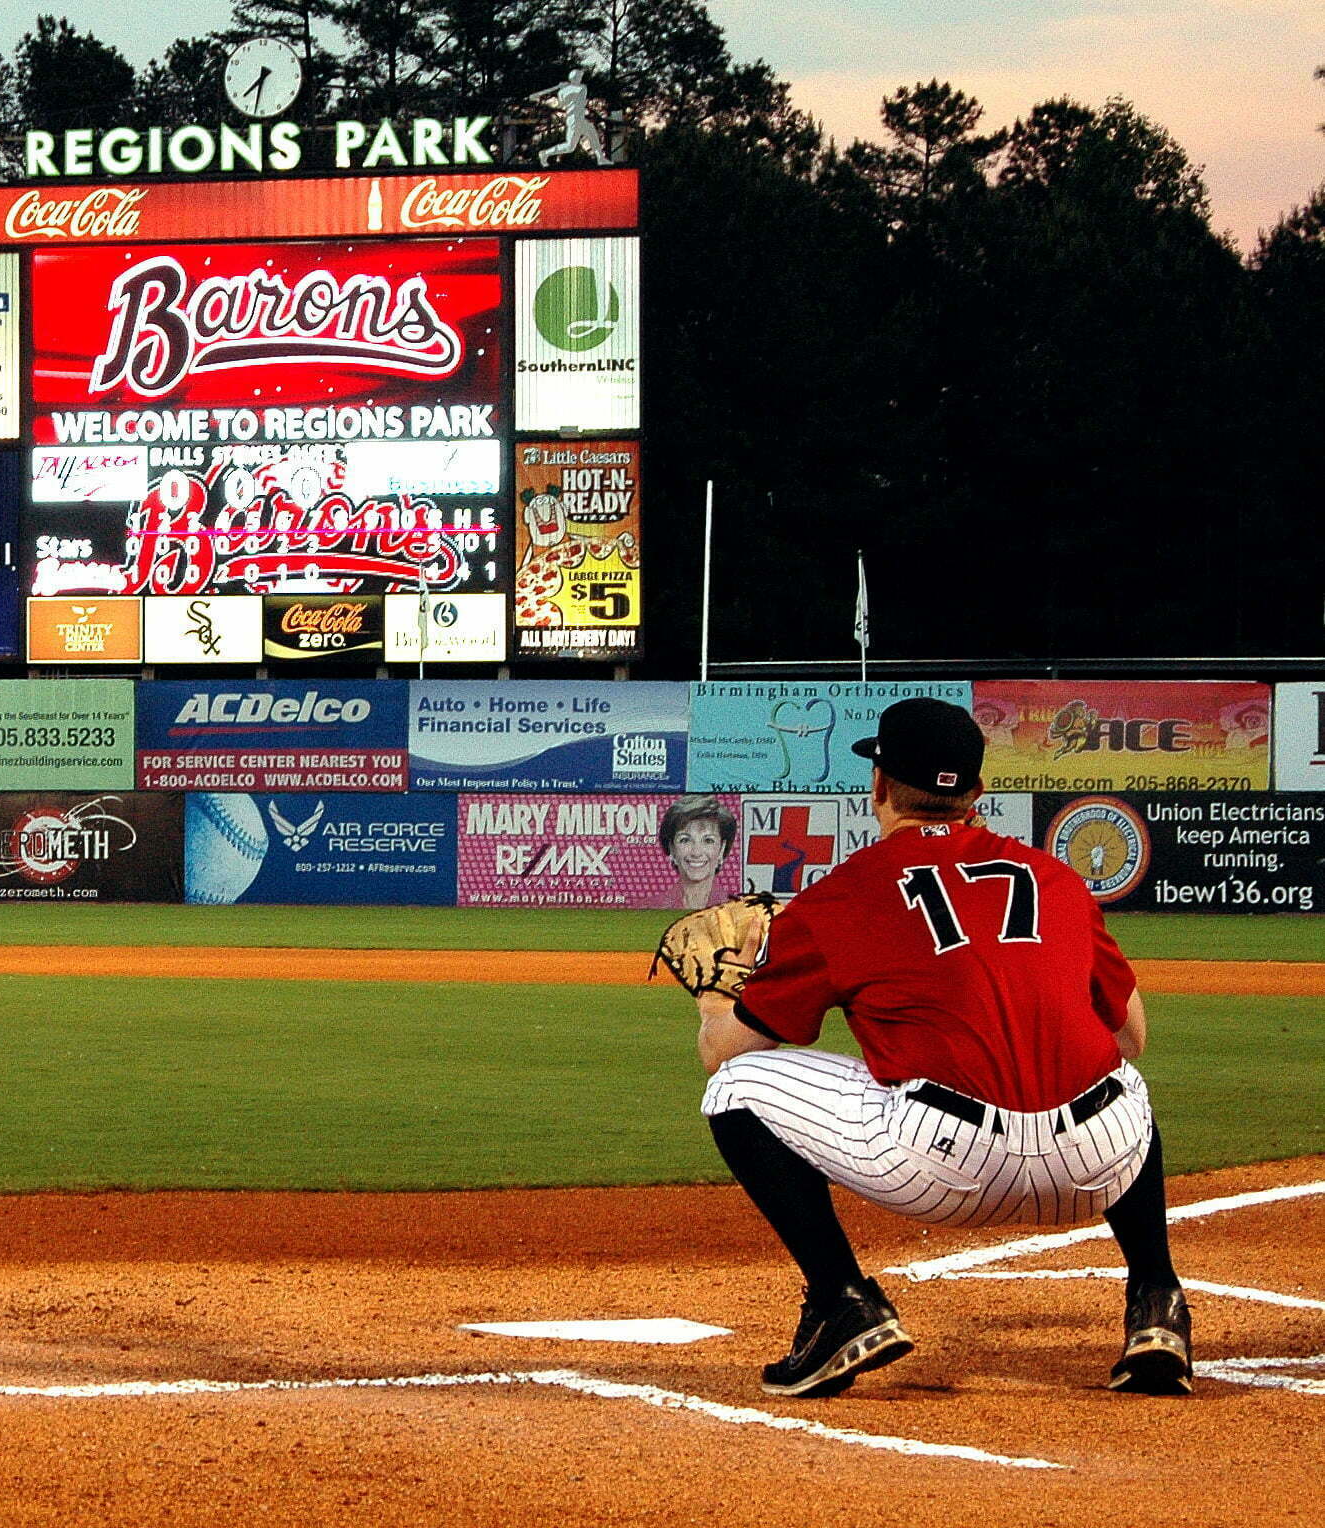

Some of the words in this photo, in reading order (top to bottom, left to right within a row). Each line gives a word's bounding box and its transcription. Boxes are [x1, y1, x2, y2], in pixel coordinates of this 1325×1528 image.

[26, 120, 302, 177] REGIONS
[335, 116, 494, 168] PARK
[400, 176, 552, 227] Coca-Cola
[4, 188, 149, 239] Coca-Cola
[88, 255, 462, 397] Barons
[517, 358, 635, 373] SouthernLINC
[51, 409, 212, 443] WELCOME
[215, 409, 262, 441] TO
[266, 406, 405, 441] REGIONS
[410, 404, 494, 438] PARK
[150, 446, 205, 466] BALLS
[543, 449, 577, 465] Little
[579, 449, 631, 465] Caesars
[562, 468, 634, 491] HOT-N-
[159, 469, 190, 510] 0
[563, 491, 632, 515] READY
[454, 508, 472, 529] H
[480, 507, 495, 529] E
[36, 535, 93, 559] Stars
[601, 571, 633, 581] PIZZA
[570, 582, 631, 621] $5
[55, 623, 113, 636] TRINITY
[520, 629, 541, 648] ALL
[696, 683, 818, 700] Birmingham
[828, 683, 964, 697] Orthodontics
[175, 691, 371, 724] ACDelco
[417, 697, 466, 713] Auto
[489, 697, 549, 713] Home
[572, 696, 611, 713] Life
[844, 708, 862, 721] No
[417, 717, 511, 733] Financial
[517, 718, 607, 734] Services
[613, 732, 666, 749] Cotton
[1086, 718, 1192, 752] ACE
[143, 755, 172, 769] FOR
[176, 755, 236, 769] SERVICE
[240, 755, 296, 768] CENTER
[299, 755, 367, 768] NEAREST
[371, 755, 402, 768] YOU
[616, 749, 665, 766] States
[144, 774, 256, 788] 1-800-ACDELCO
[264, 774, 403, 787] WWW.ACDELCO.COM
[416, 777, 436, 787] Our
[437, 777, 461, 787] Most
[463, 777, 509, 789] Important
[511, 777, 538, 790] Policy
[541, 778, 550, 788] Is
[991, 774, 1113, 791] acetribe.com
[1125, 775, 1252, 792] 205-868-2370
[466, 803, 550, 835] MARY
[555, 803, 658, 837] MILTON
[1147, 803, 1203, 821] Union
[1210, 803, 1325, 821] Electricians
[323, 822, 362, 837] AIR
[368, 822, 445, 837] FORCE
[1176, 825, 1225, 848] keep
[1228, 826, 1311, 845] America
[329, 838, 437, 852] RESERVE
[367, 863, 437, 873] AFReserve.com
[1203, 850, 1285, 872] running.
[0, 886, 98, 898] zerometh.com
[494, 878, 614, 888] ADVANTAGE
[469, 893, 626, 905] www.marymilton.com
[1154, 879, 1314, 910] ibew136.org
[896, 859, 1043, 955] 17
